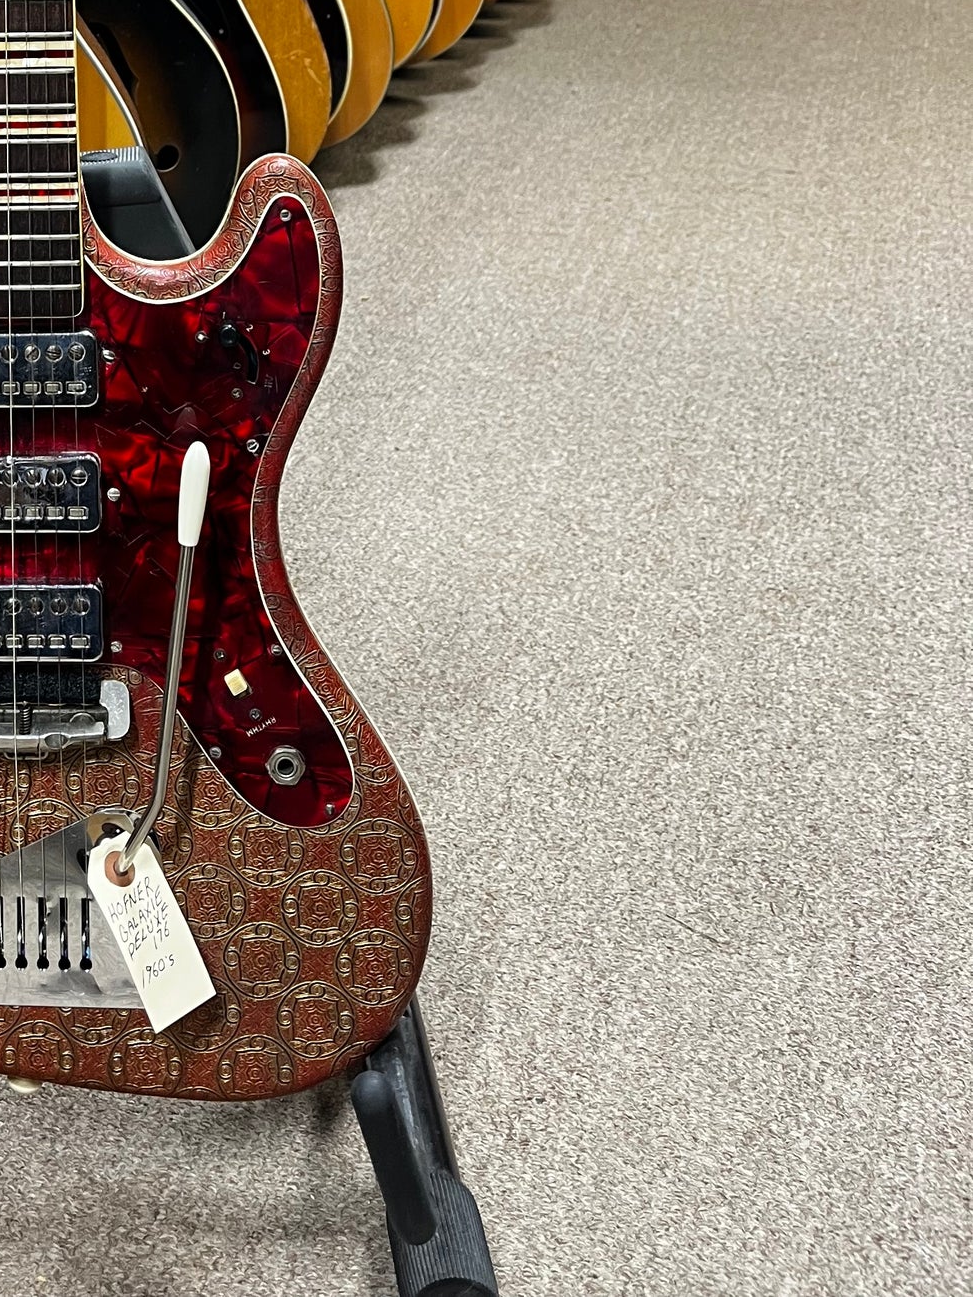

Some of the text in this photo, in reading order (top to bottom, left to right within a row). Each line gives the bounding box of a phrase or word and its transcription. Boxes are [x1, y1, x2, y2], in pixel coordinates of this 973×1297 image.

[246, 324, 254, 333] 2
[246, 717, 277, 737] RHYTHM
[108, 876, 156, 923] HOFNER
[127, 904, 169, 961] DELUXE
[153, 926, 170, 950] 176
[141, 953, 175, 989] 1960's
